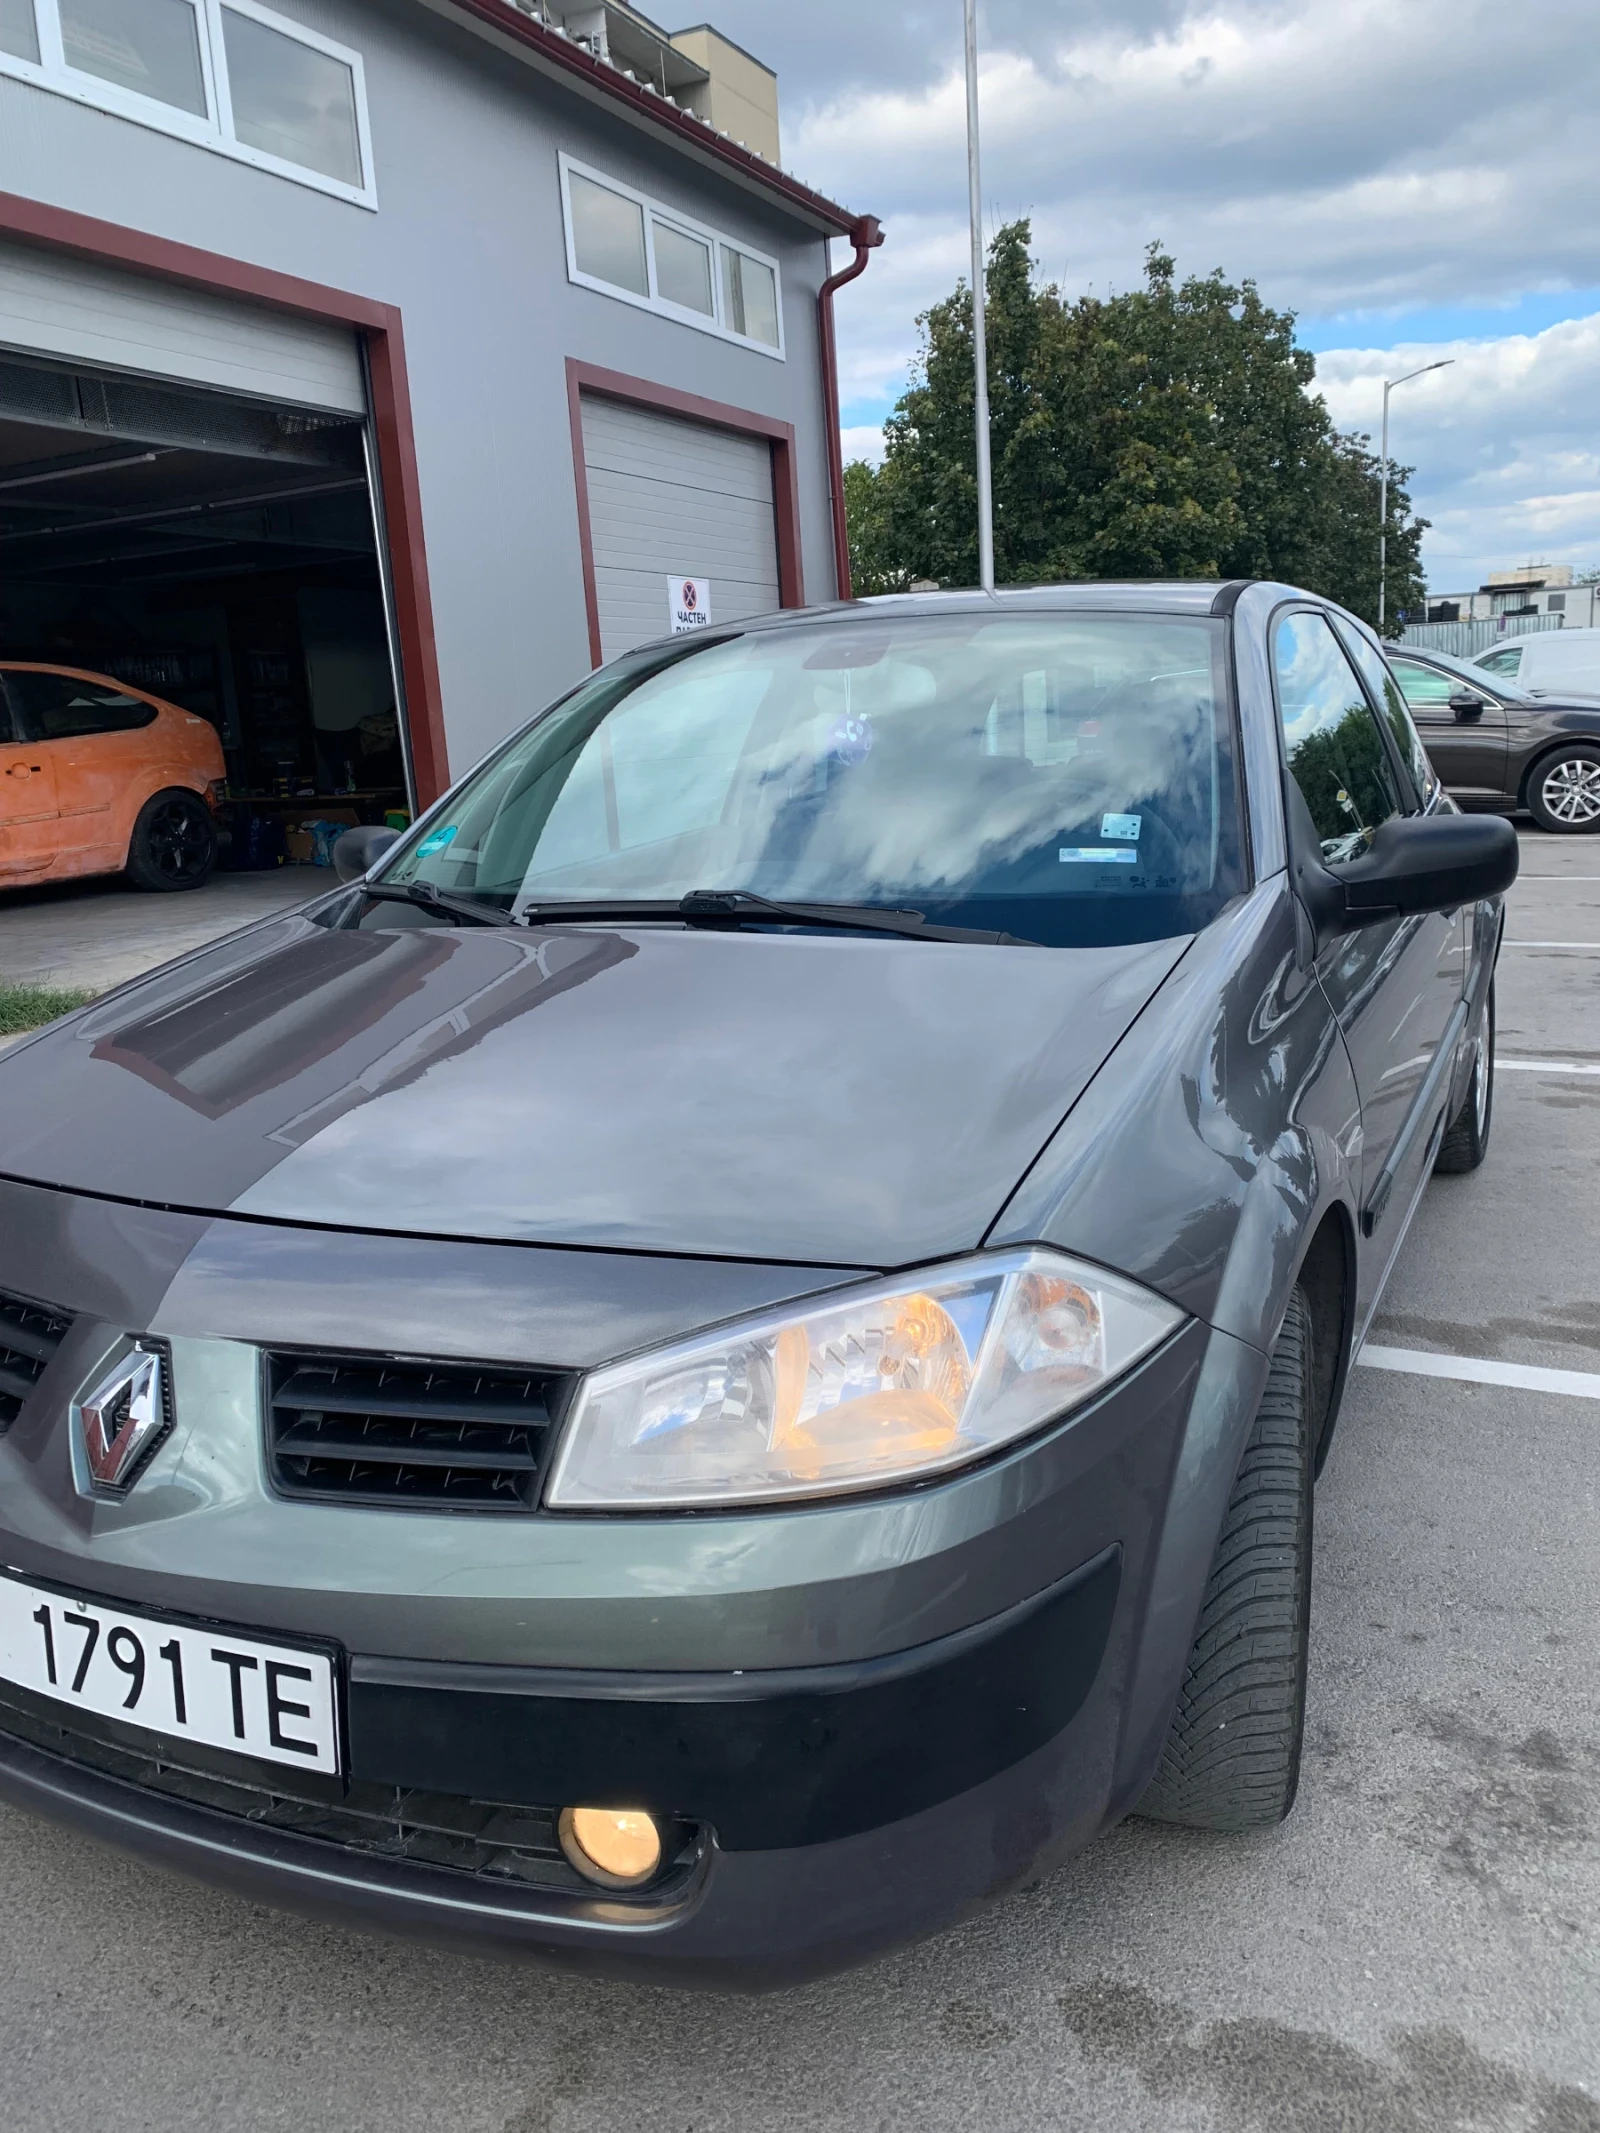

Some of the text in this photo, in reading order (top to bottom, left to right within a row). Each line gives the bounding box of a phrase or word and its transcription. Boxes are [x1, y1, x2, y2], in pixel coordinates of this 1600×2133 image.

[677, 611, 706, 624] ЧАСТЕН
[33, 1604, 319, 1757] 1791 TE
